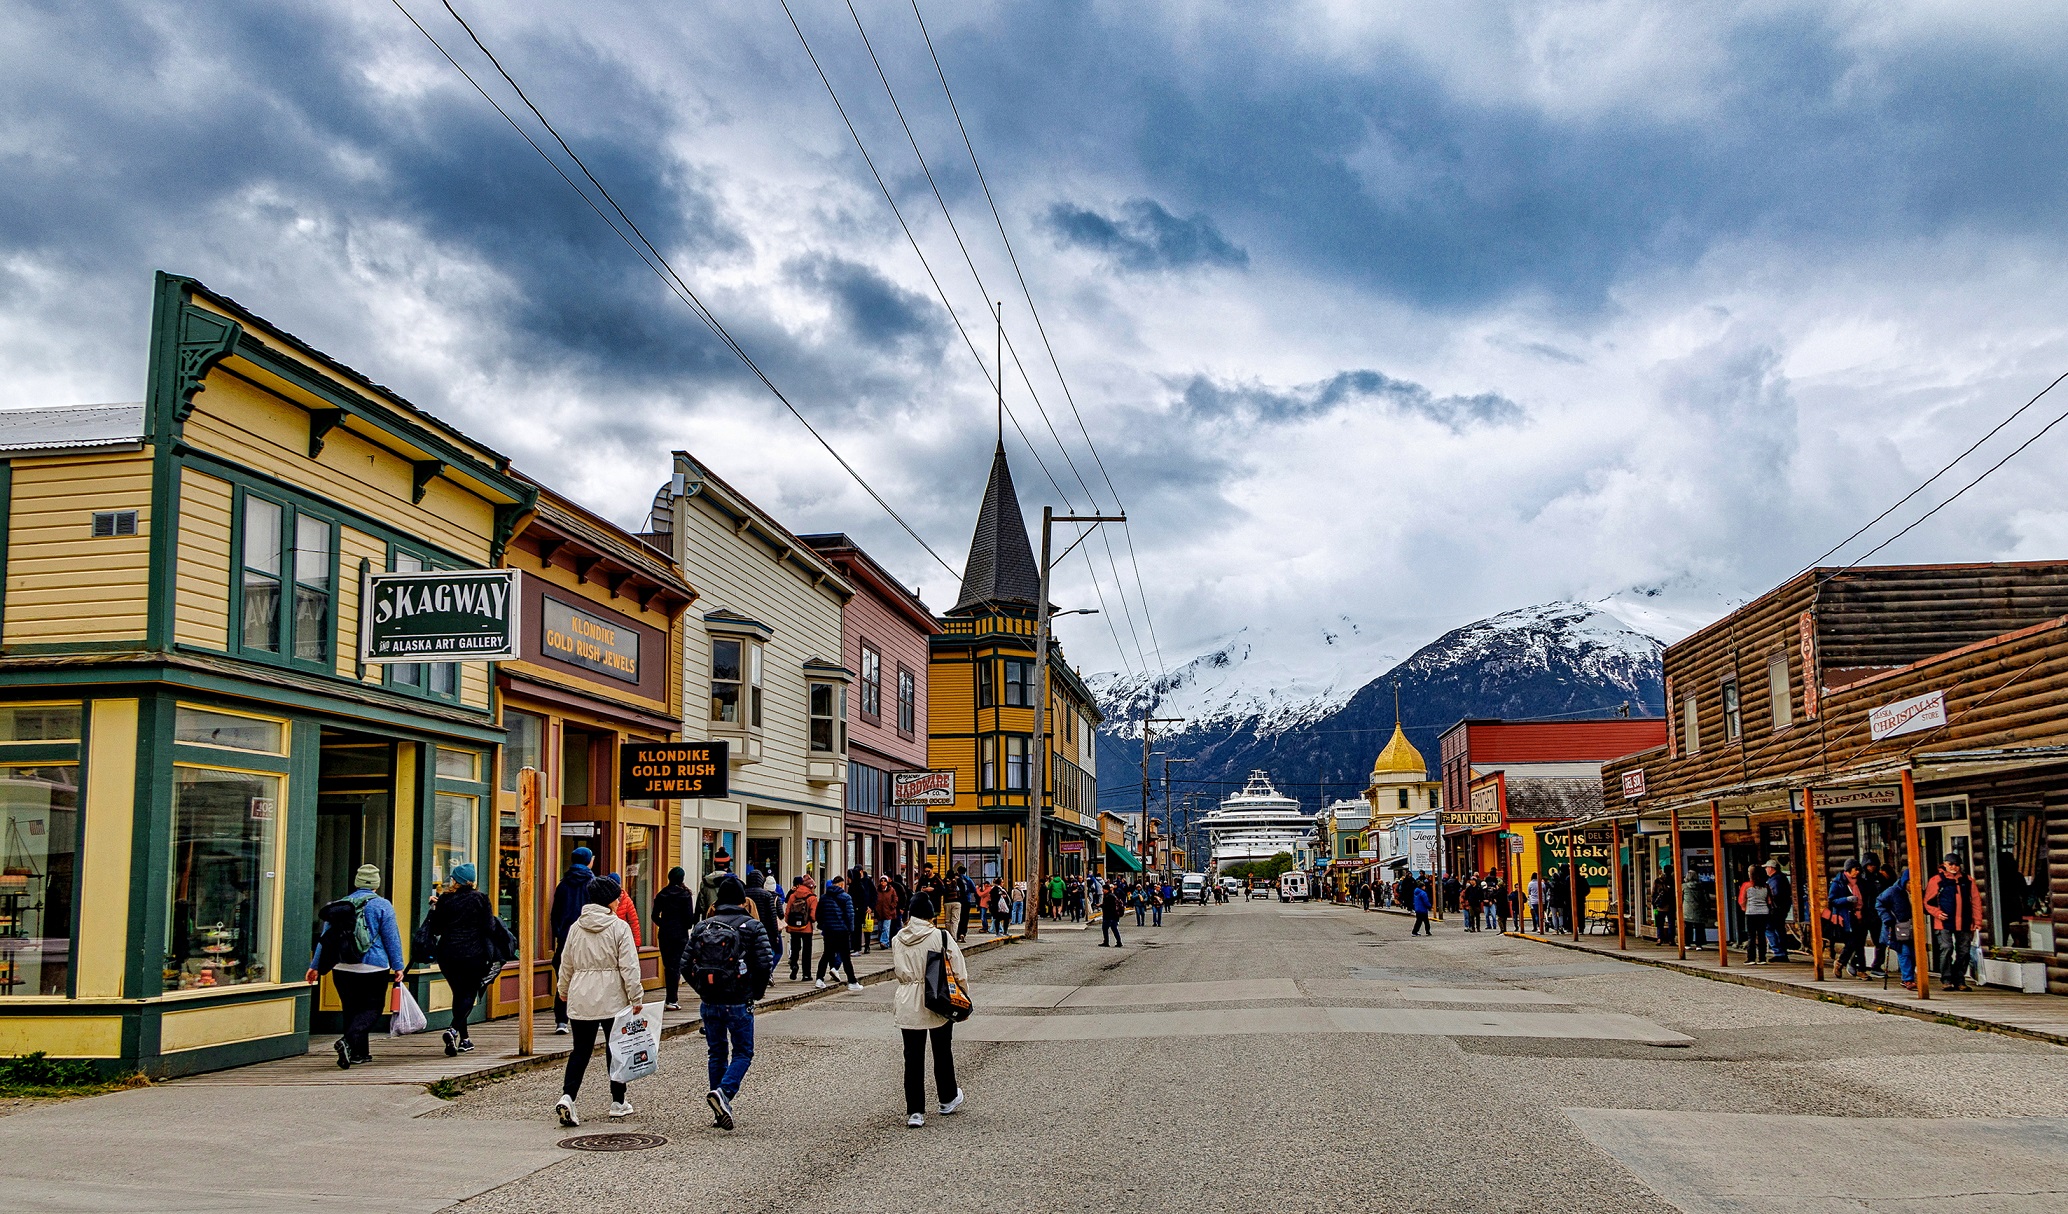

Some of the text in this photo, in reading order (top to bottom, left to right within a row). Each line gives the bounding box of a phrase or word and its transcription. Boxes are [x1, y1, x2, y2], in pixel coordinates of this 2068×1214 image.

[376, 582, 509, 624] SKAGWAY
[572, 616, 615, 646] KLONDIKE
[392, 639, 432, 652] ALASKA
[435, 638, 456, 650] ART
[458, 636, 504, 648] GALLERY
[546, 630, 635, 674] GOLD RUSH JEWELS
[1872, 696, 1940, 734] CHRISTMAS
[1874, 709, 1893, 720] ALASKA
[1922, 710, 1940, 722] STORE
[638, 750, 710, 762] KLONDIKE
[632, 764, 716, 777] GOLD RUSH
[645, 780, 702, 792] JEWELS
[896, 774, 950, 798] HARDWARE
[1450, 813, 1499, 824] PANTHEON
[1605, 832, 1614, 840] SO
